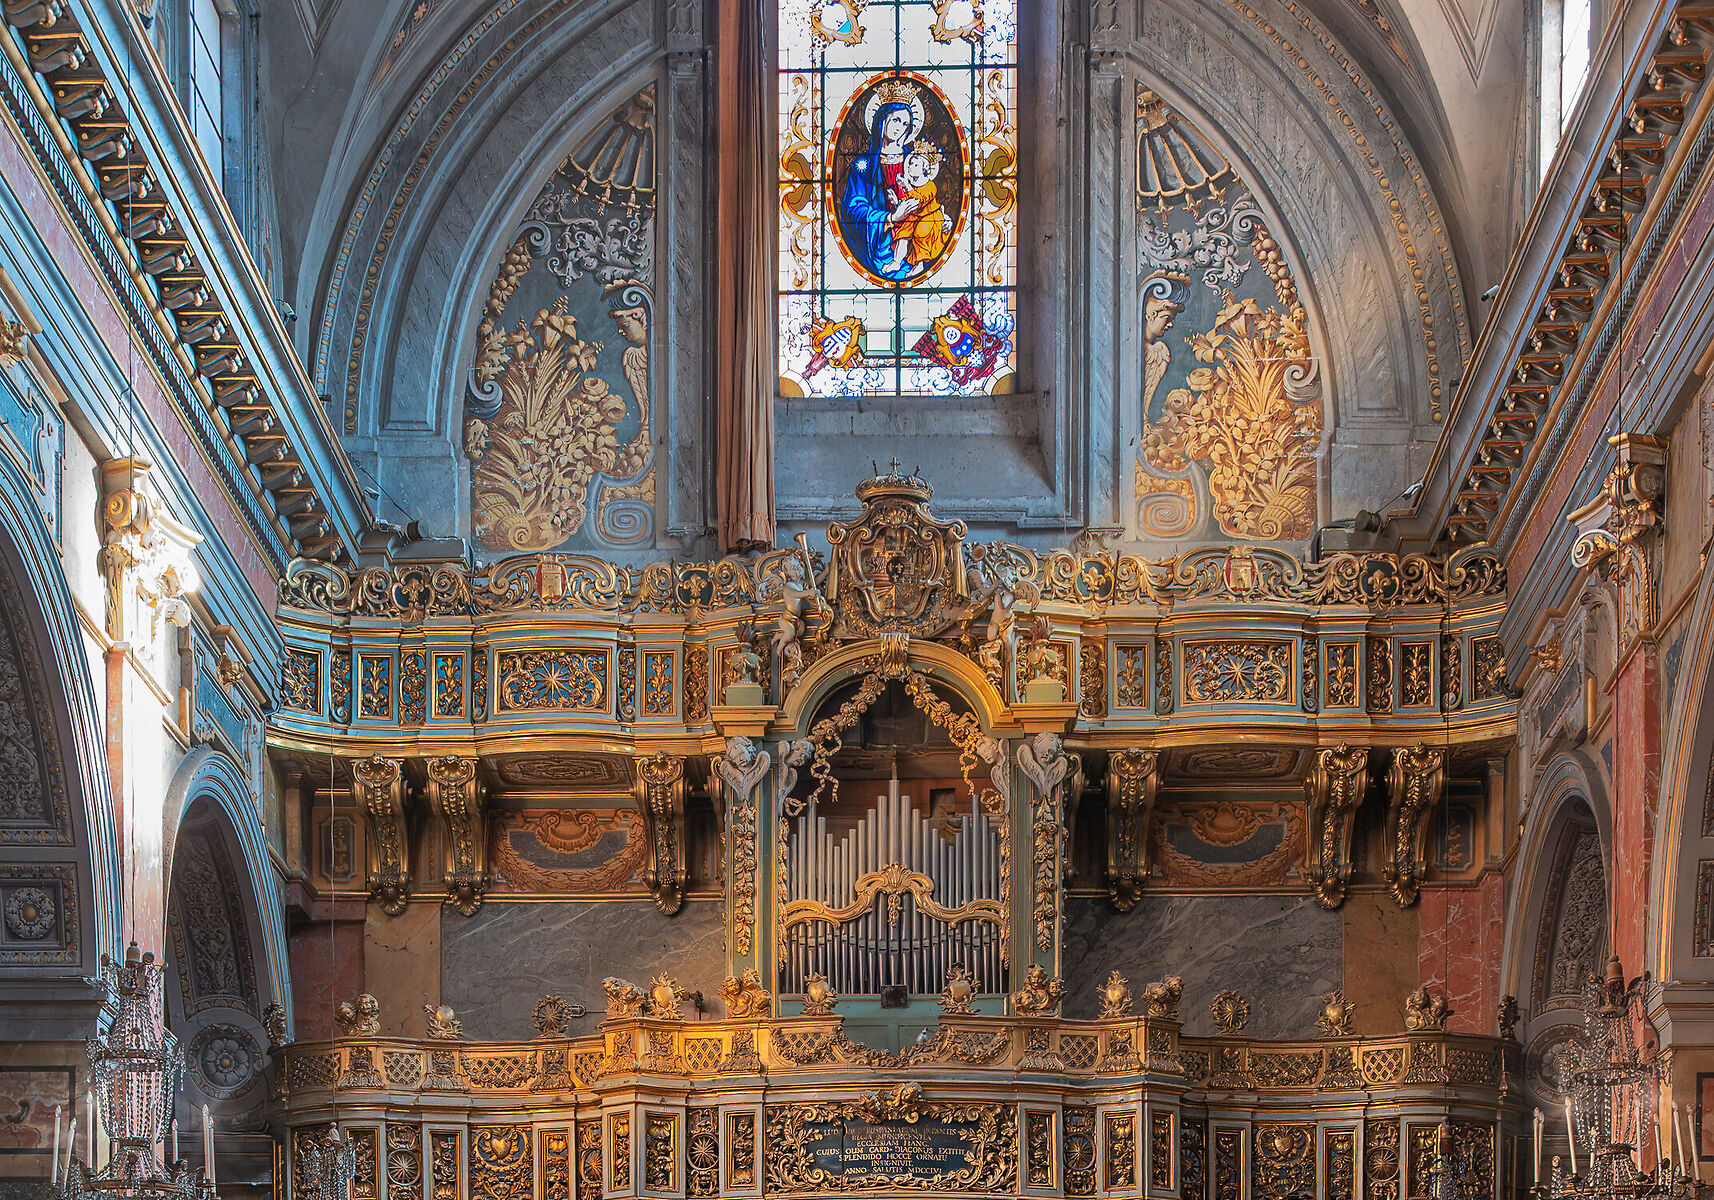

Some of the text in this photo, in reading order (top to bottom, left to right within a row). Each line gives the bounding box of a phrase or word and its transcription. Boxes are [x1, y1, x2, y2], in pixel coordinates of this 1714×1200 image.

[845, 1147, 864, 1155] OLIM
[894, 1146, 934, 1154] DIACONUS
[838, 1154, 882, 1162] SPLENDIDO
[915, 1154, 948, 1162] ORNATU
